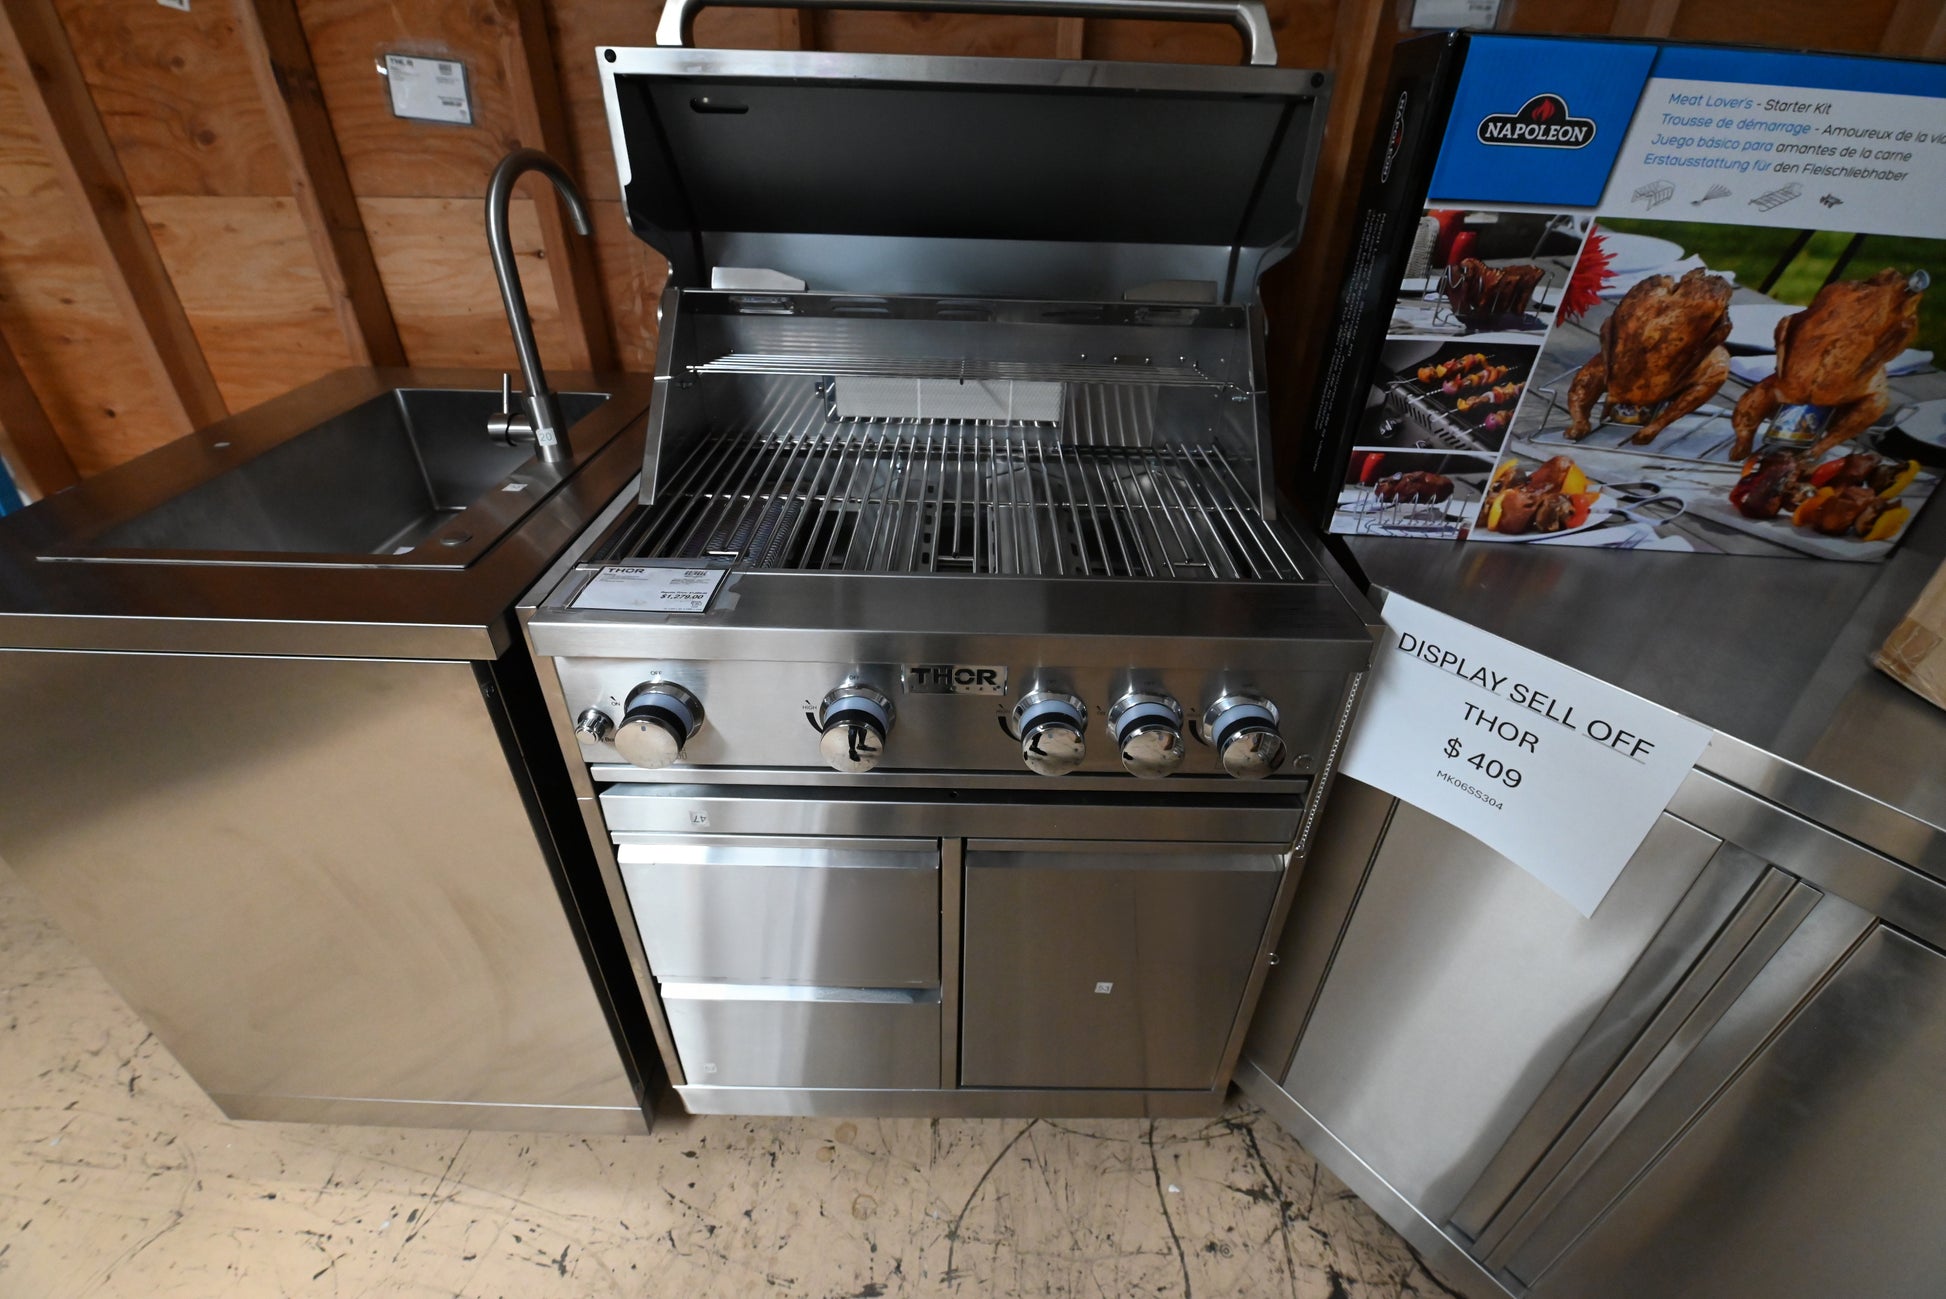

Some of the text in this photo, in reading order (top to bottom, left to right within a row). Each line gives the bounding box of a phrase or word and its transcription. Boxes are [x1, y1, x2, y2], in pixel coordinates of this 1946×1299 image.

[1668, 93, 1703, 106] Meat
[1705, 96, 1754, 109] Lover's
[1763, 99, 1812, 113] Starter
[1813, 102, 1832, 115] Kit
[1484, 122, 1588, 142] NAPOLEON
[1661, 113, 1713, 127] Trousse
[1716, 118, 1733, 129] de
[1736, 118, 1811, 136] démarrage
[1821, 124, 1893, 140] Amoureux
[1895, 131, 1913, 142] de
[1915, 131, 1928, 143] la
[1651, 133, 1912, 162] Juego básico para amantes de la carne
[1643, 153, 1908, 181] Erstausstattung für den Fleischliebhaber
[539, 431, 553, 442] 20
[910, 668, 997, 685] THOR
[1398, 632, 1655, 757] DISPLAY SELL OFF
[1464, 701, 1539, 754] THOR
[1443, 737, 1522, 789] $ 409
[1436, 769, 1503, 810] MK06SS304
